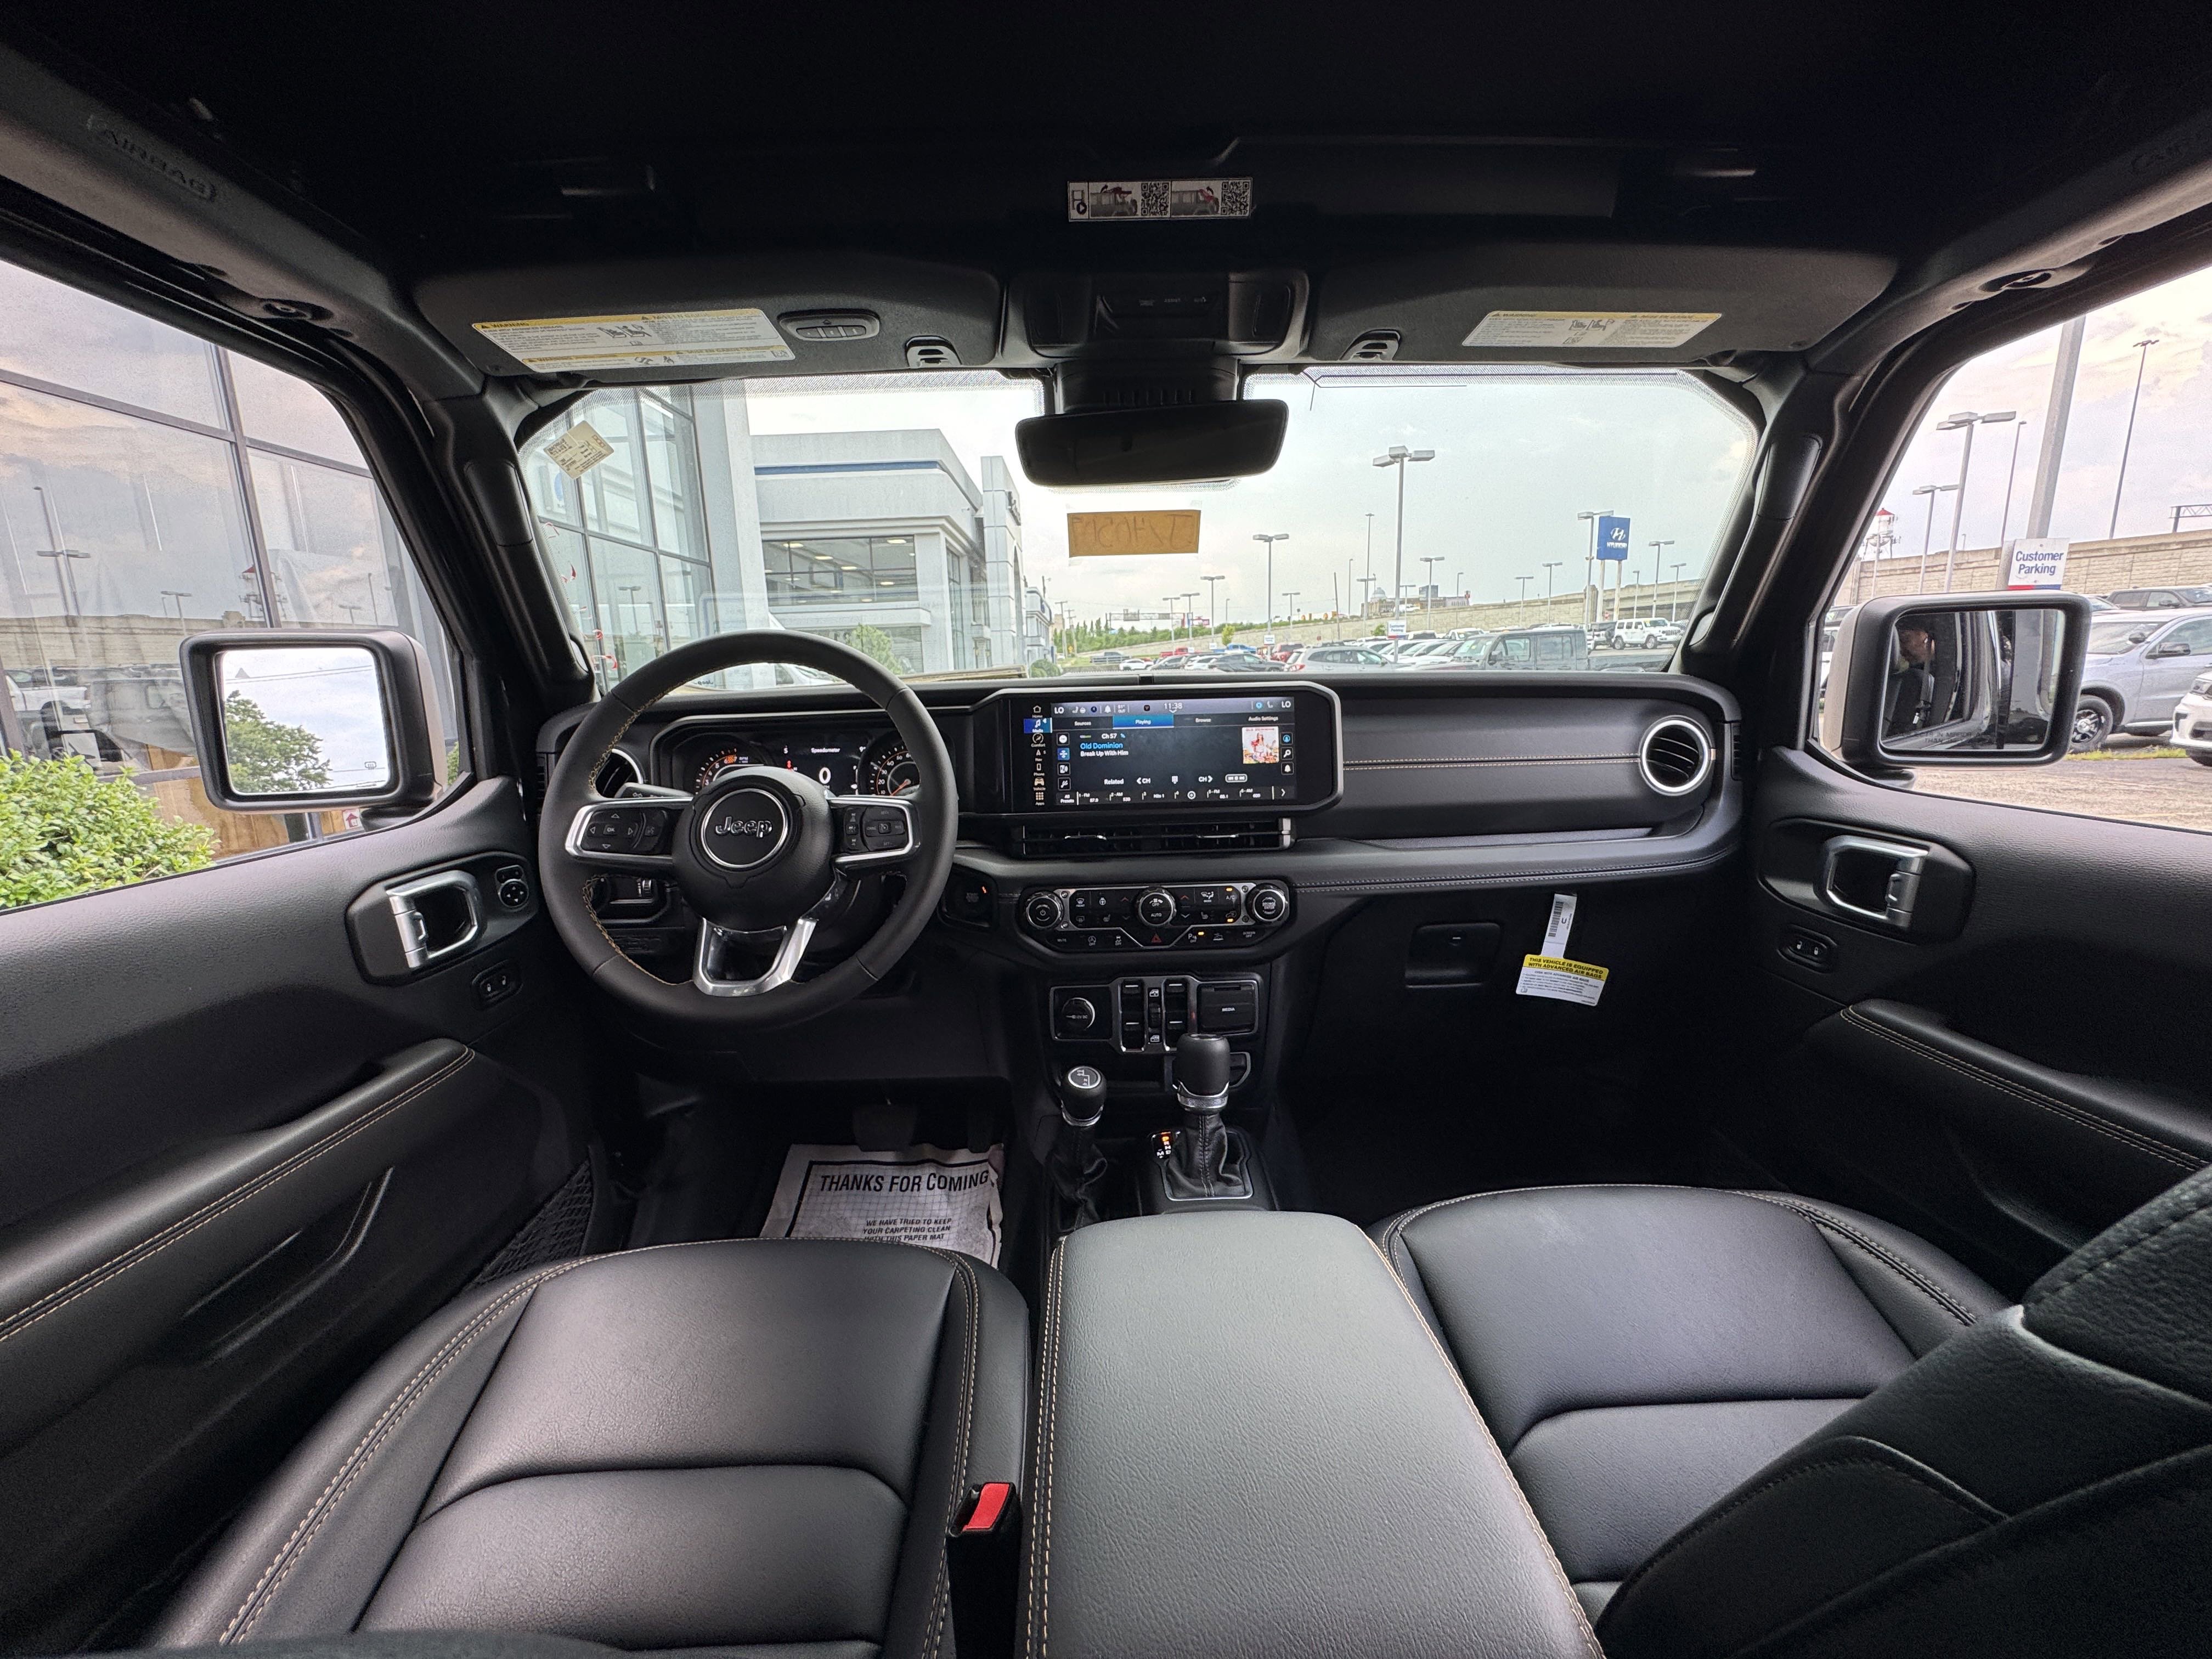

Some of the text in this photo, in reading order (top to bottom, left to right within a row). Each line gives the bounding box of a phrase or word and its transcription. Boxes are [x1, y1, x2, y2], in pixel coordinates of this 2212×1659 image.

[2016, 551, 2064, 562] Customer
[2018, 563, 2056, 576] Parking
[819, 768, 831, 784] 0
[715, 816, 773, 838] Jeep
[1543, 964, 1574, 972] ADVANCED
[1573, 964, 1604, 974] EQUIPPED
[820, 1170, 989, 1192] THANKS FOR COMING
[927, 1225, 951, 1233] CLEAN
